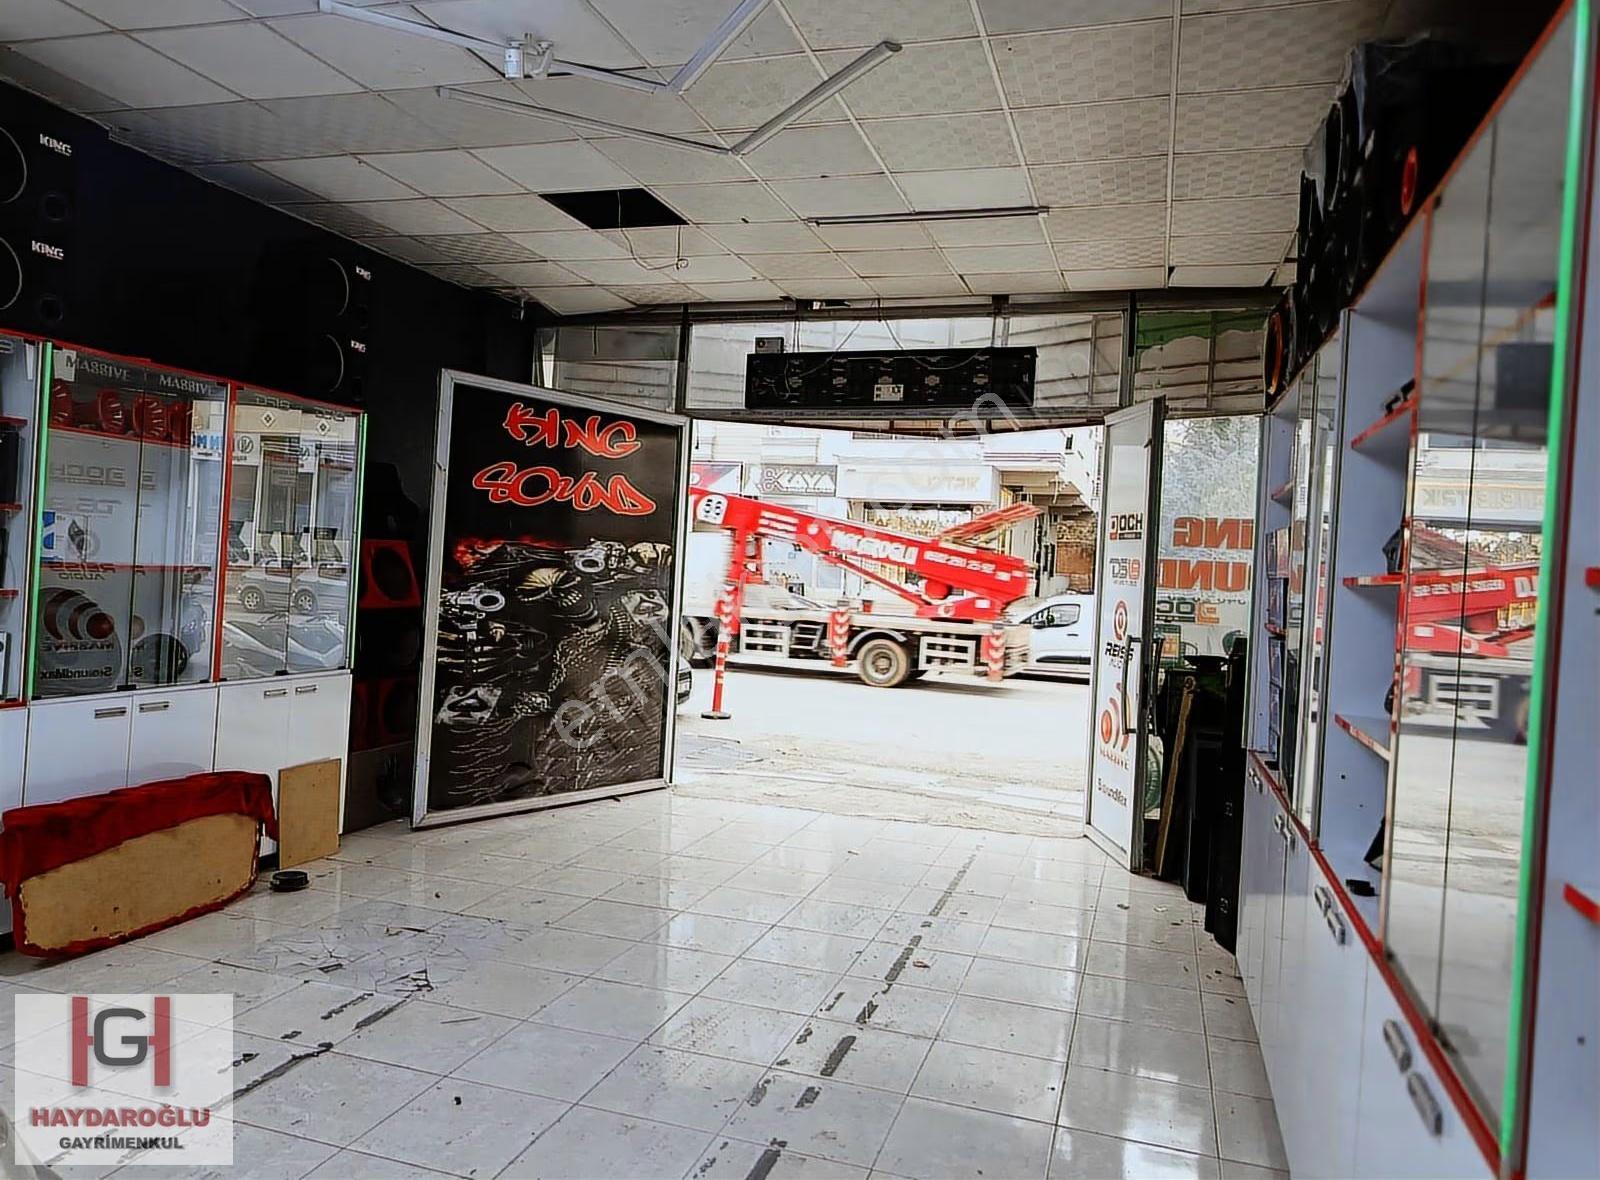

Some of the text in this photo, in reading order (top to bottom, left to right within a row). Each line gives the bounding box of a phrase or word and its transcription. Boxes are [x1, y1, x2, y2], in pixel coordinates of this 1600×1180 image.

[40, 133, 72, 155] KING
[32, 240, 64, 259] KING
[503, 402, 641, 458] KING
[472, 461, 656, 515] SOUND
